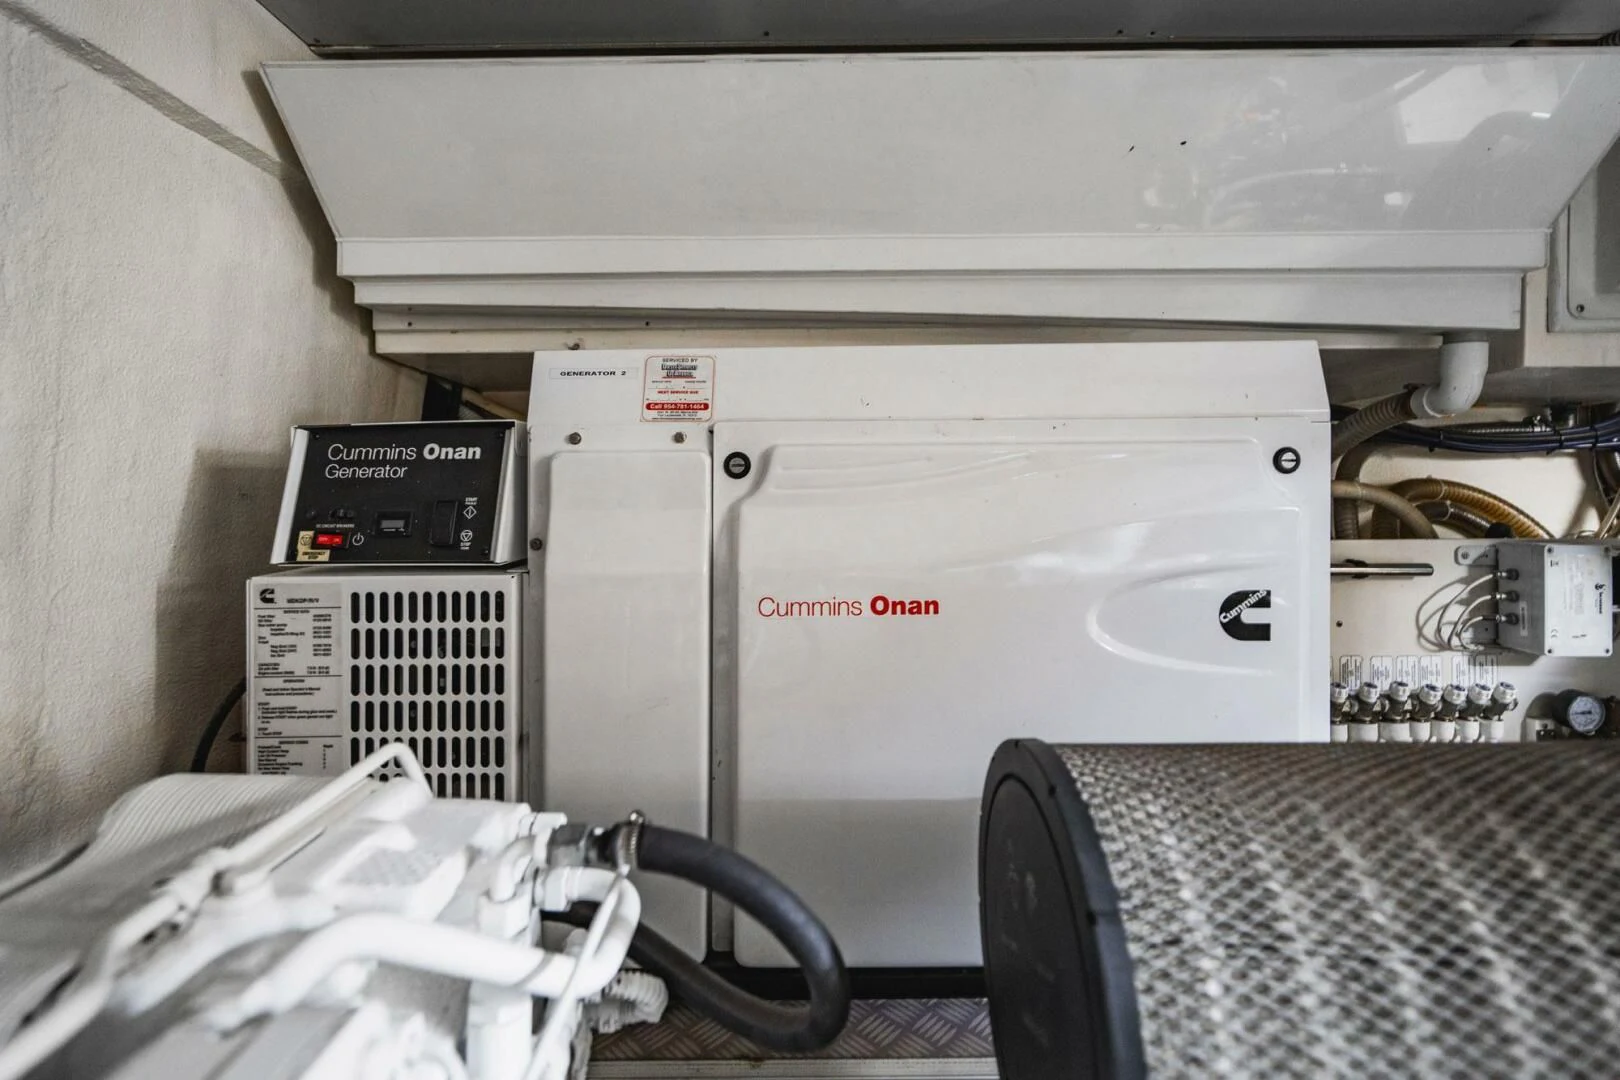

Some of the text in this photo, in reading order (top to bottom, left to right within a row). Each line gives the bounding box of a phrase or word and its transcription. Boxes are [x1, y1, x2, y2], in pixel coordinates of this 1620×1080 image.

[327, 442, 482, 461] Cummins Onan
[324, 463, 408, 479] Generator
[758, 595, 940, 617] Cummins Onan
[1219, 589, 1268, 624] Cummins
